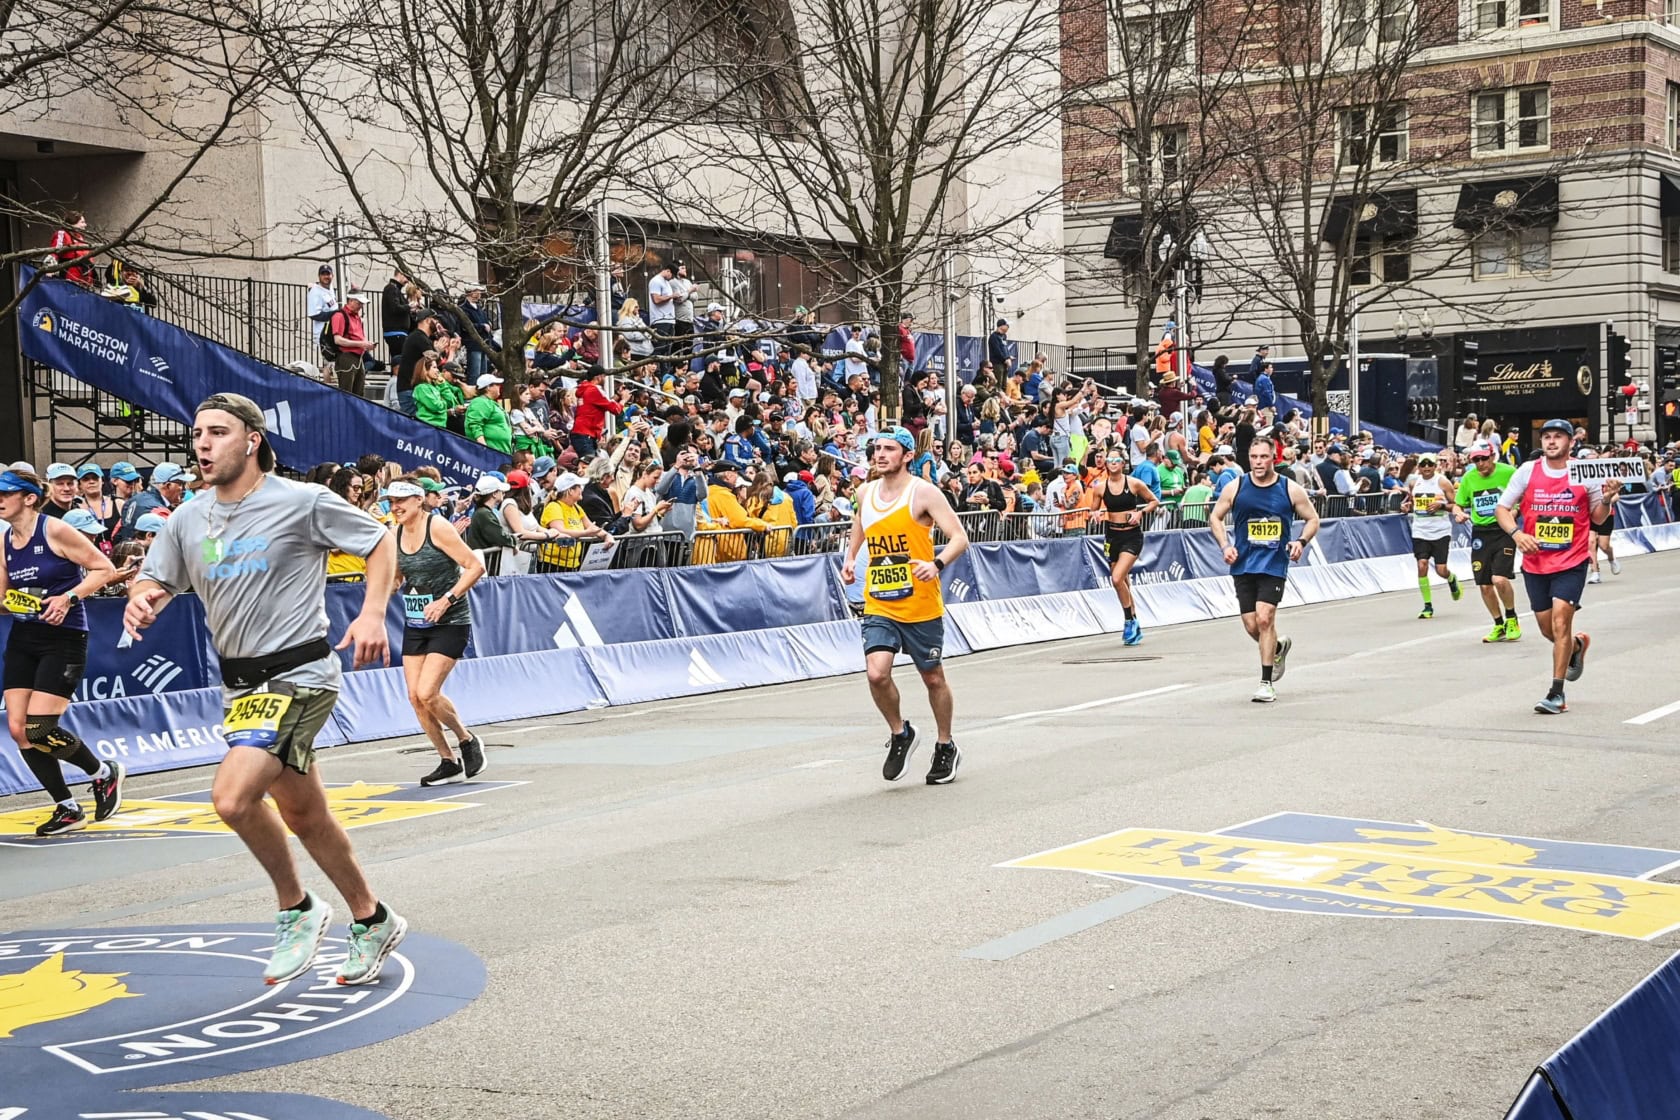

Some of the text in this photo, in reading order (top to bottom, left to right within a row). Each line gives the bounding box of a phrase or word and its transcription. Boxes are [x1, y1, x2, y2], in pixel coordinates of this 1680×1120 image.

[60, 316, 129, 353] THE BOSTON
[58, 328, 127, 366] MARATHON
[1488, 363, 1540, 380] Lindt
[396, 439, 434, 460] BANK
[436, 453, 453, 467] OF
[1569, 461, 1643, 484] #JUDISTRONG
[1475, 496, 1498, 508] 23594
[1531, 503, 1580, 513] JUDISTRONG
[1250, 524, 1279, 536] 29123
[1538, 524, 1570, 538] 24298
[867, 534, 909, 555] HALE
[206, 557, 269, 581] JOHN
[871, 567, 908, 585] 25653
[228, 697, 283, 723] 24545
[96, 738, 129, 759] OF
